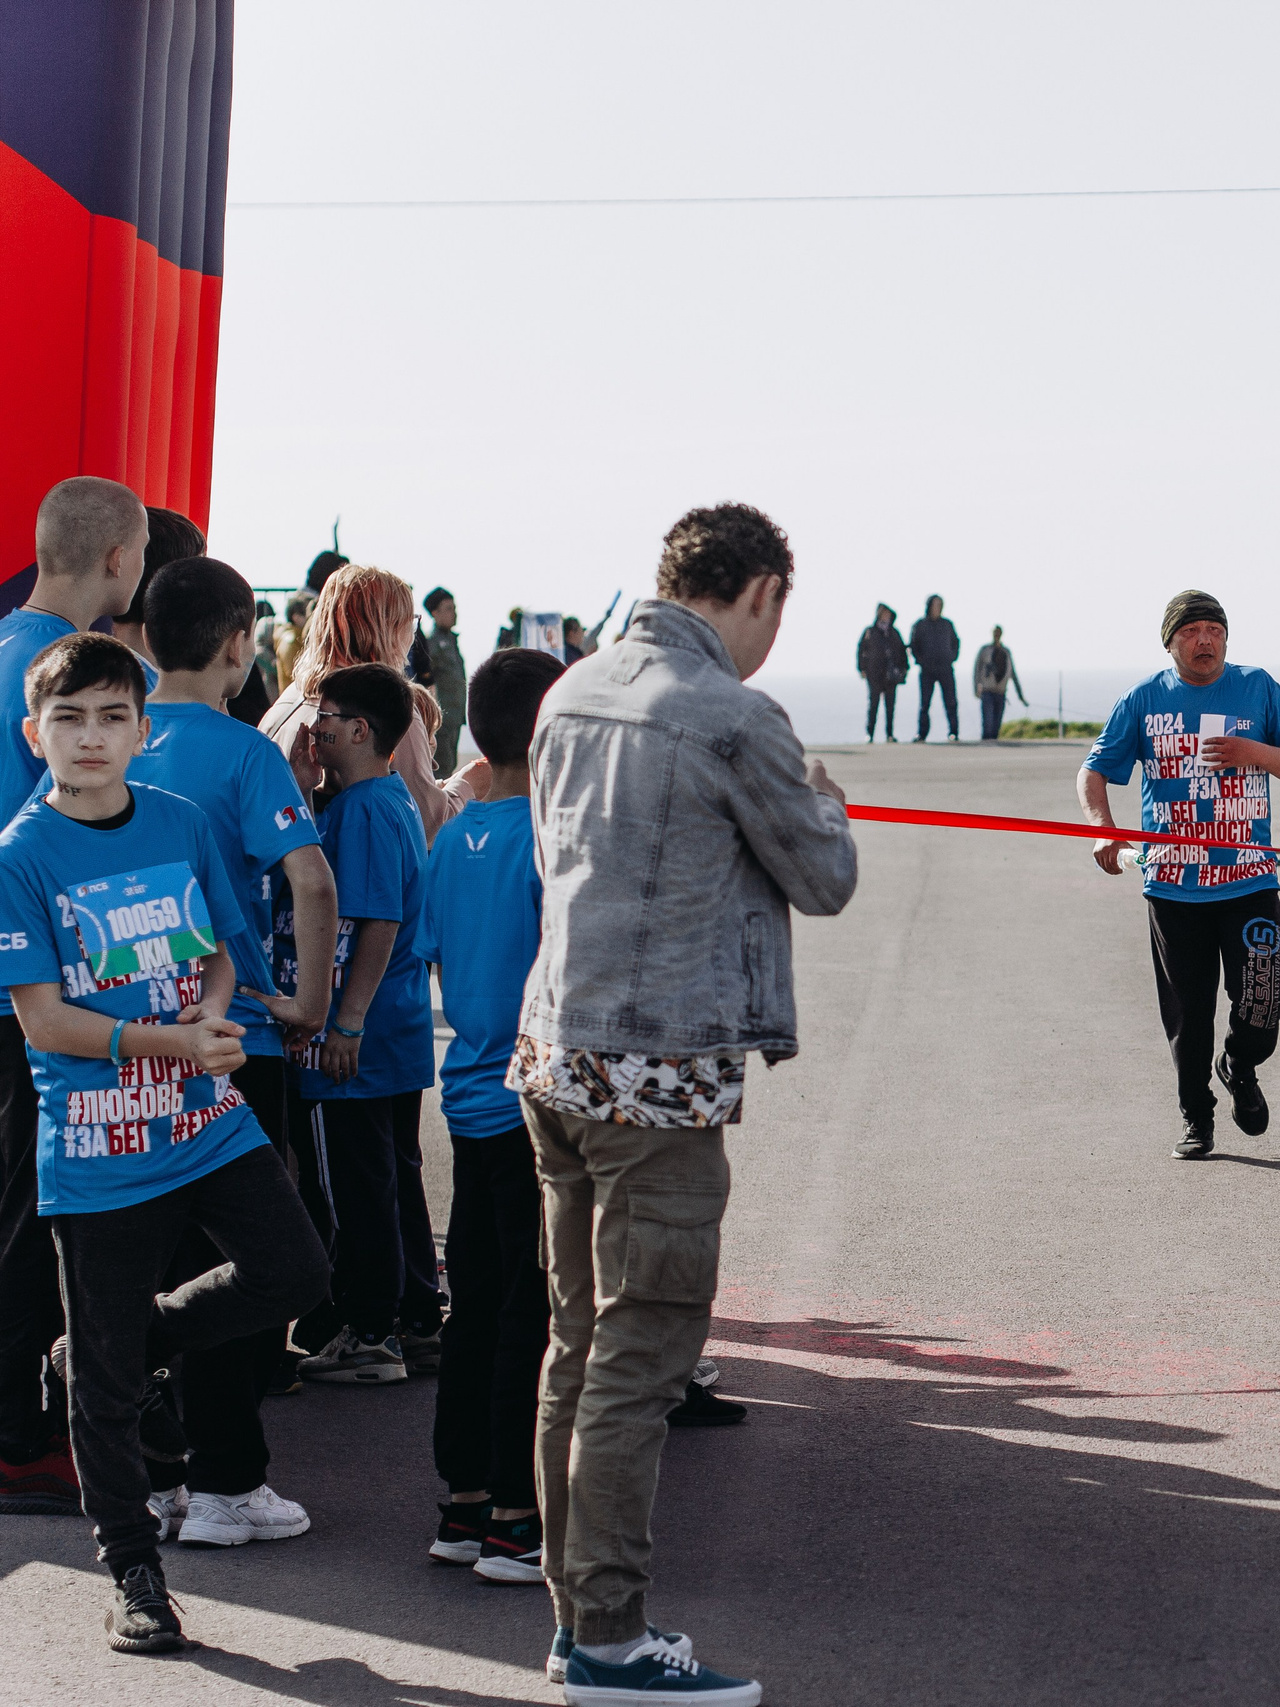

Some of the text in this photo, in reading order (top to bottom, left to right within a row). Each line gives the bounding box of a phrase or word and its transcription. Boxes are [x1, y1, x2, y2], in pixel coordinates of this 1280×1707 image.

[1145, 712, 1185, 737] 2024
[1152, 800, 1198, 823] #ЗАБЕГ
[88, 882, 109, 894] ПСБ
[106, 896, 181, 942] 10059
[67, 1081, 185, 1125] #ЛЮБОВЬ
[63, 1120, 151, 1158] #ЗАБЕГ
